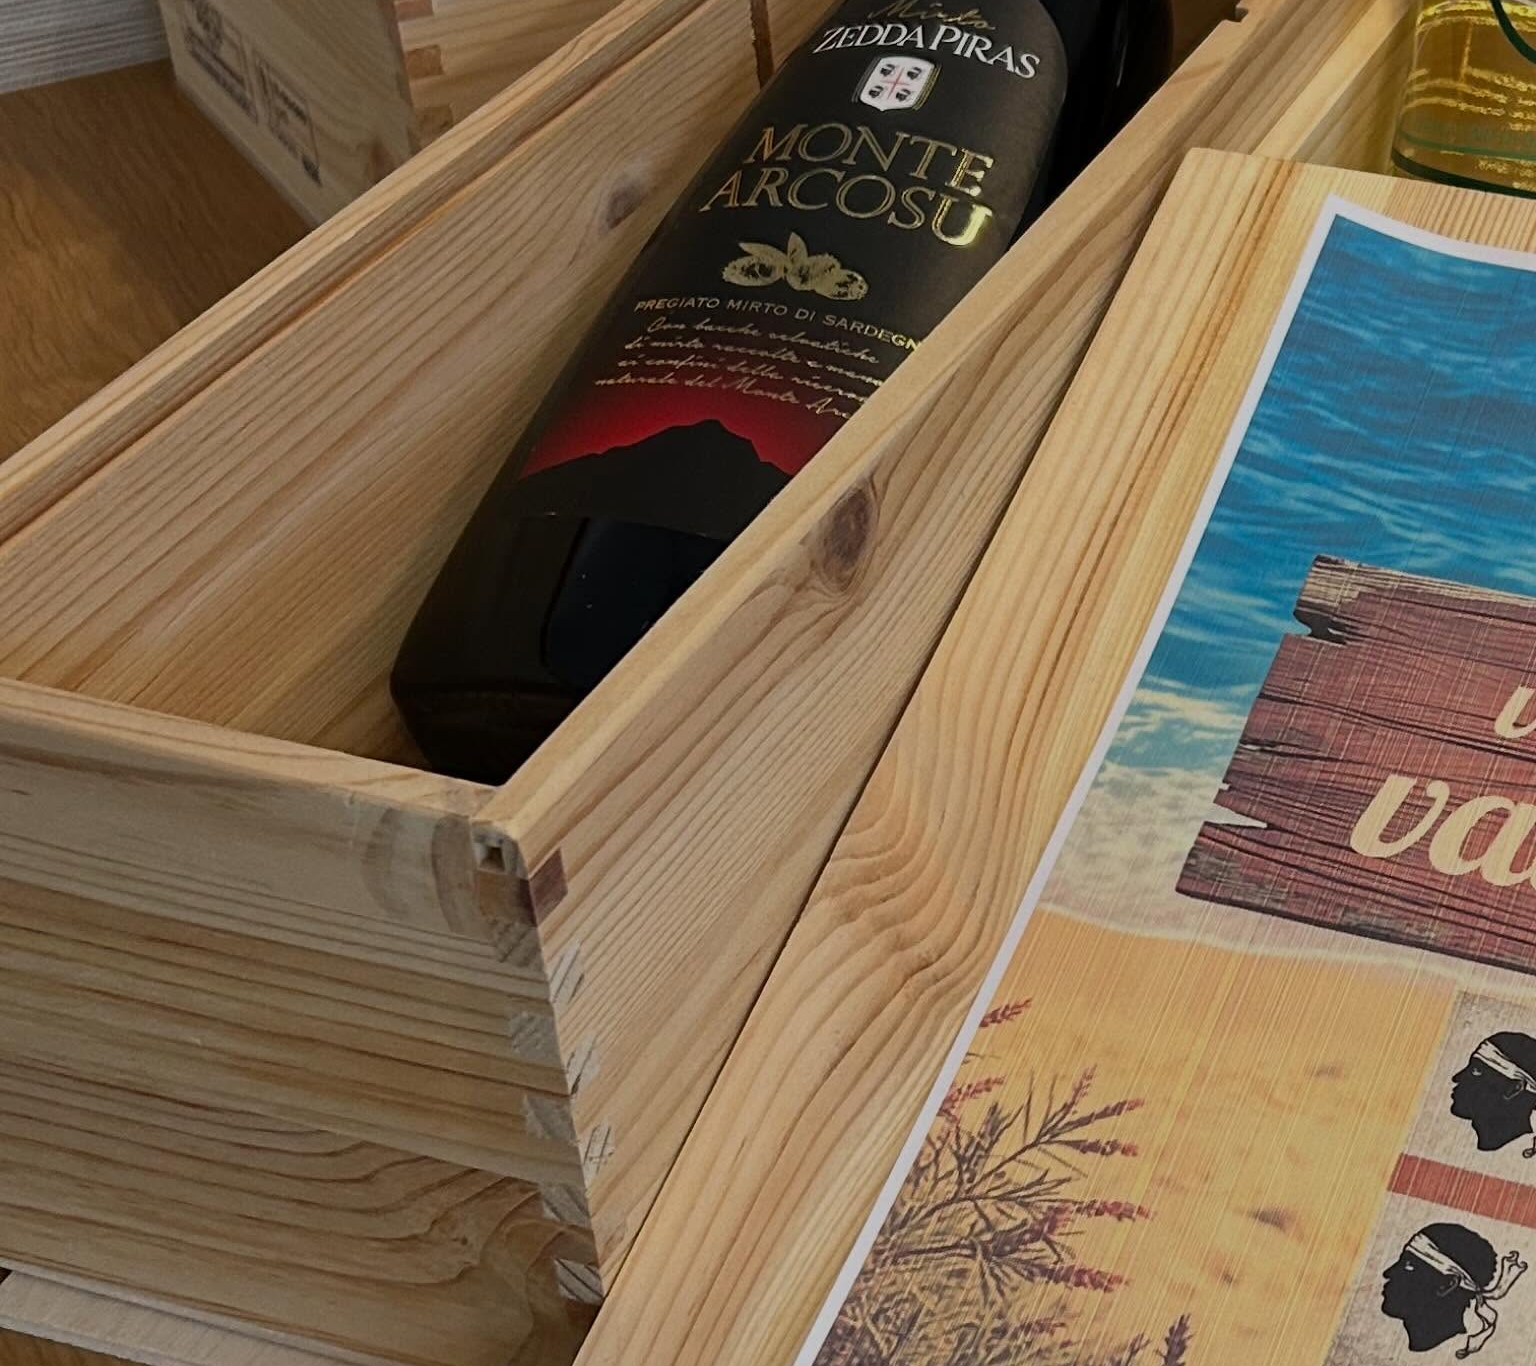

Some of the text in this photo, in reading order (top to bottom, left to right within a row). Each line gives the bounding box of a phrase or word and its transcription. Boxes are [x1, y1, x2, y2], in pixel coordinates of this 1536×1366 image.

[928, 24, 1041, 79] PIRAS
[744, 121, 996, 197] MONTE
[700, 168, 996, 247] ARCOSU
[633, 296, 923, 353] PREGIATO MIRTO DI SARDEGN
